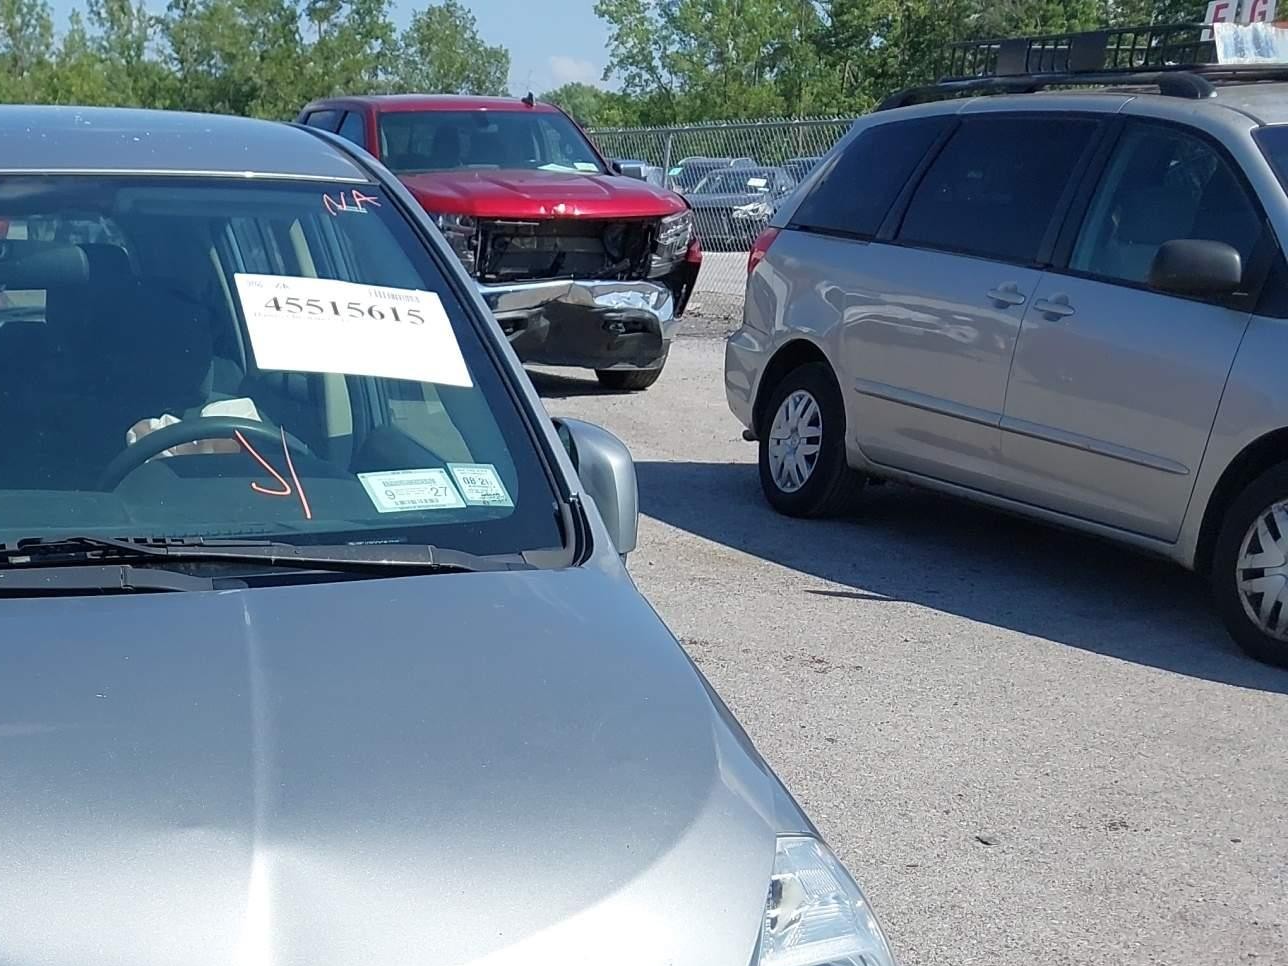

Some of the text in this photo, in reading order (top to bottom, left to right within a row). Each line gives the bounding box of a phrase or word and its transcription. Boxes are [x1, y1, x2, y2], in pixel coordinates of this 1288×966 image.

[264, 296, 425, 325] 45515615
[384, 489, 396, 500] 9
[430, 486, 448, 497] 27
